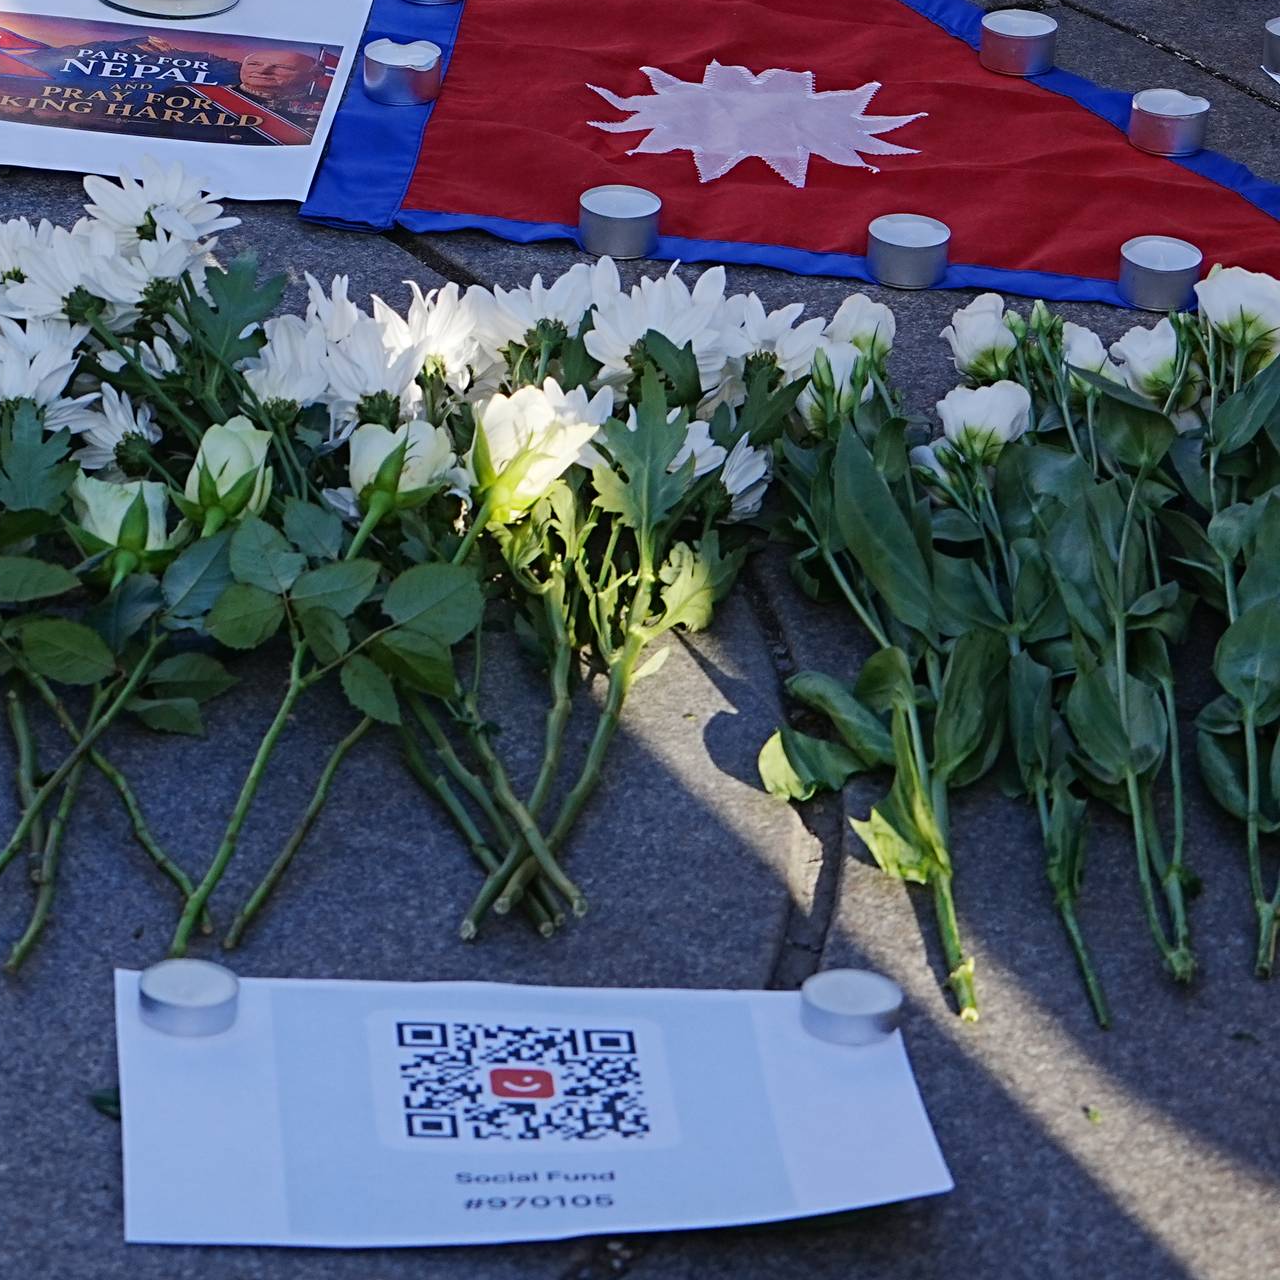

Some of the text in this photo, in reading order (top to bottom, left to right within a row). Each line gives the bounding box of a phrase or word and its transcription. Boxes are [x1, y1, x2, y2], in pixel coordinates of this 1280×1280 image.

[76, 48, 210, 70] PARY FOR
[59, 58, 219, 86] NEPAL
[110, 82, 154, 91] AND
[41, 85, 214, 111] PRAY FOR
[0, 94, 265, 128] KING HARALD
[455, 1170, 616, 1184] Social Fund
[465, 1194, 614, 1210] #970105
